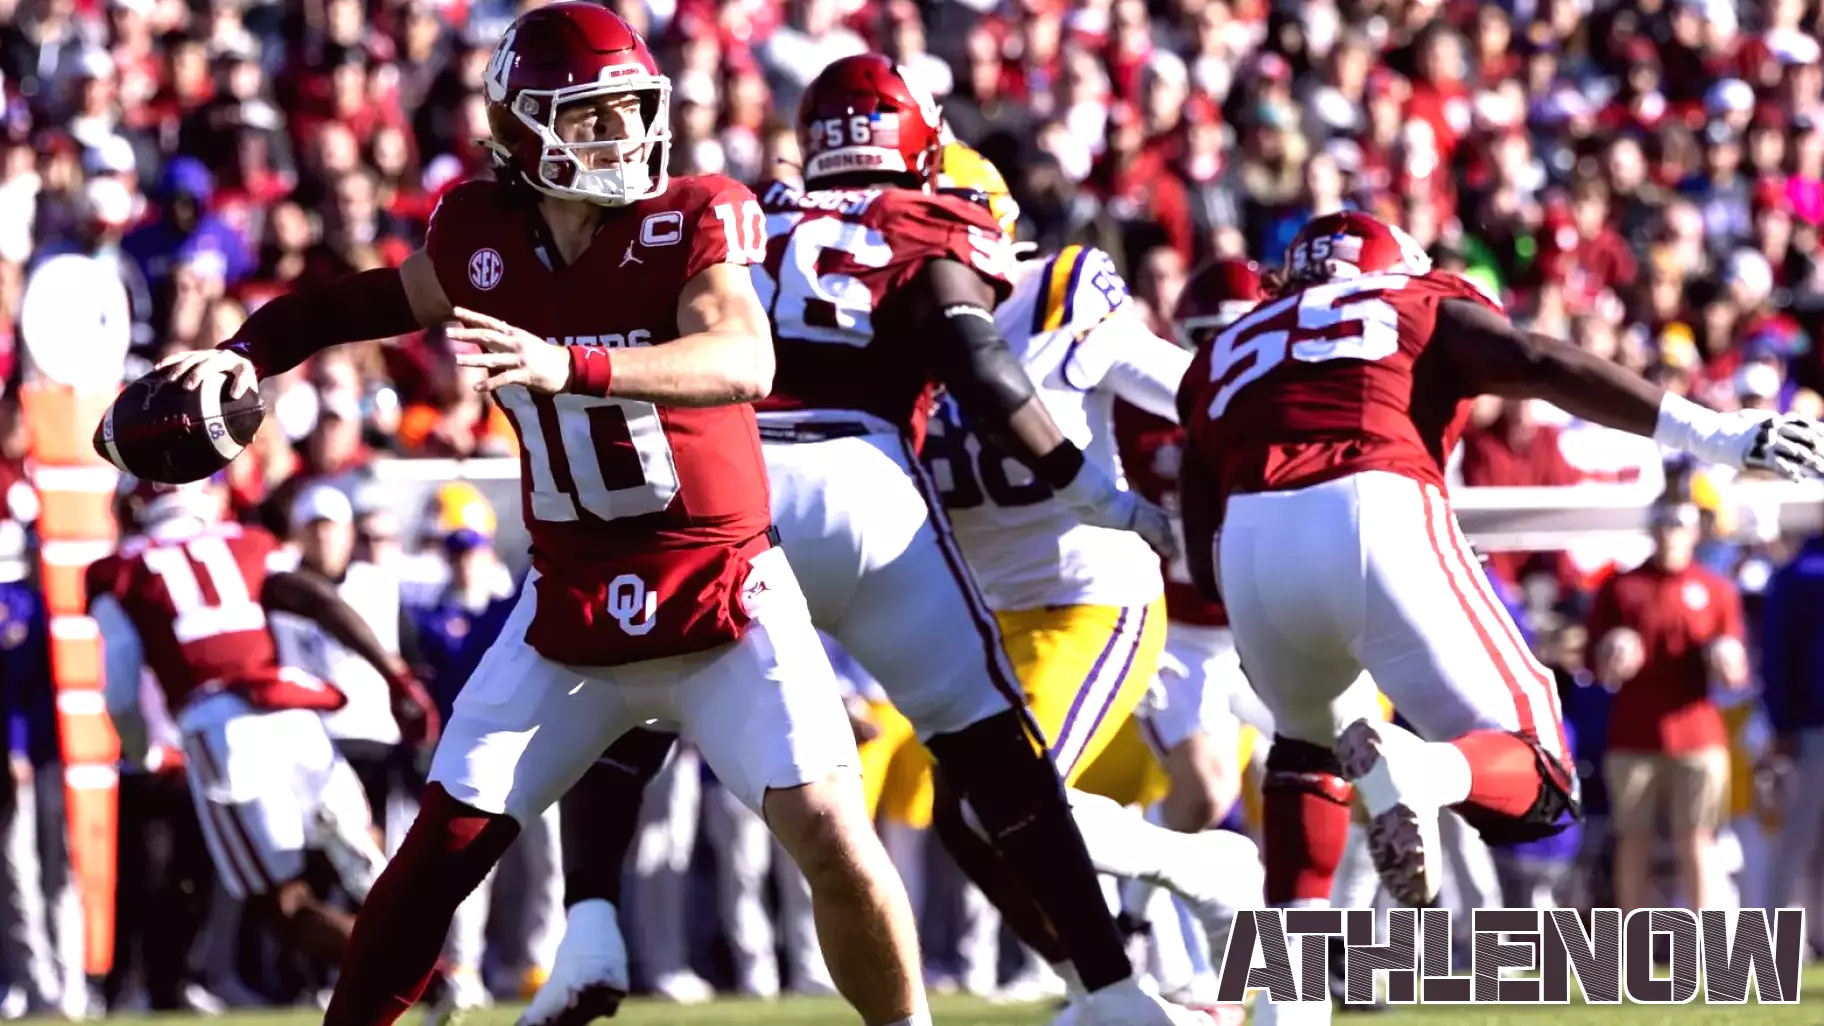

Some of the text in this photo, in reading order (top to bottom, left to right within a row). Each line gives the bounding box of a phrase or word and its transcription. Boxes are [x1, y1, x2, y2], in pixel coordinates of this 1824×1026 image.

[825, 115, 871, 147] 56
[641, 212, 682, 247] C
[715, 199, 767, 264] 10
[471, 254, 502, 284] SEC
[1208, 275, 1409, 421] 55
[494, 383, 680, 522] 10
[142, 535, 267, 643] 11
[608, 573, 657, 637] OU
